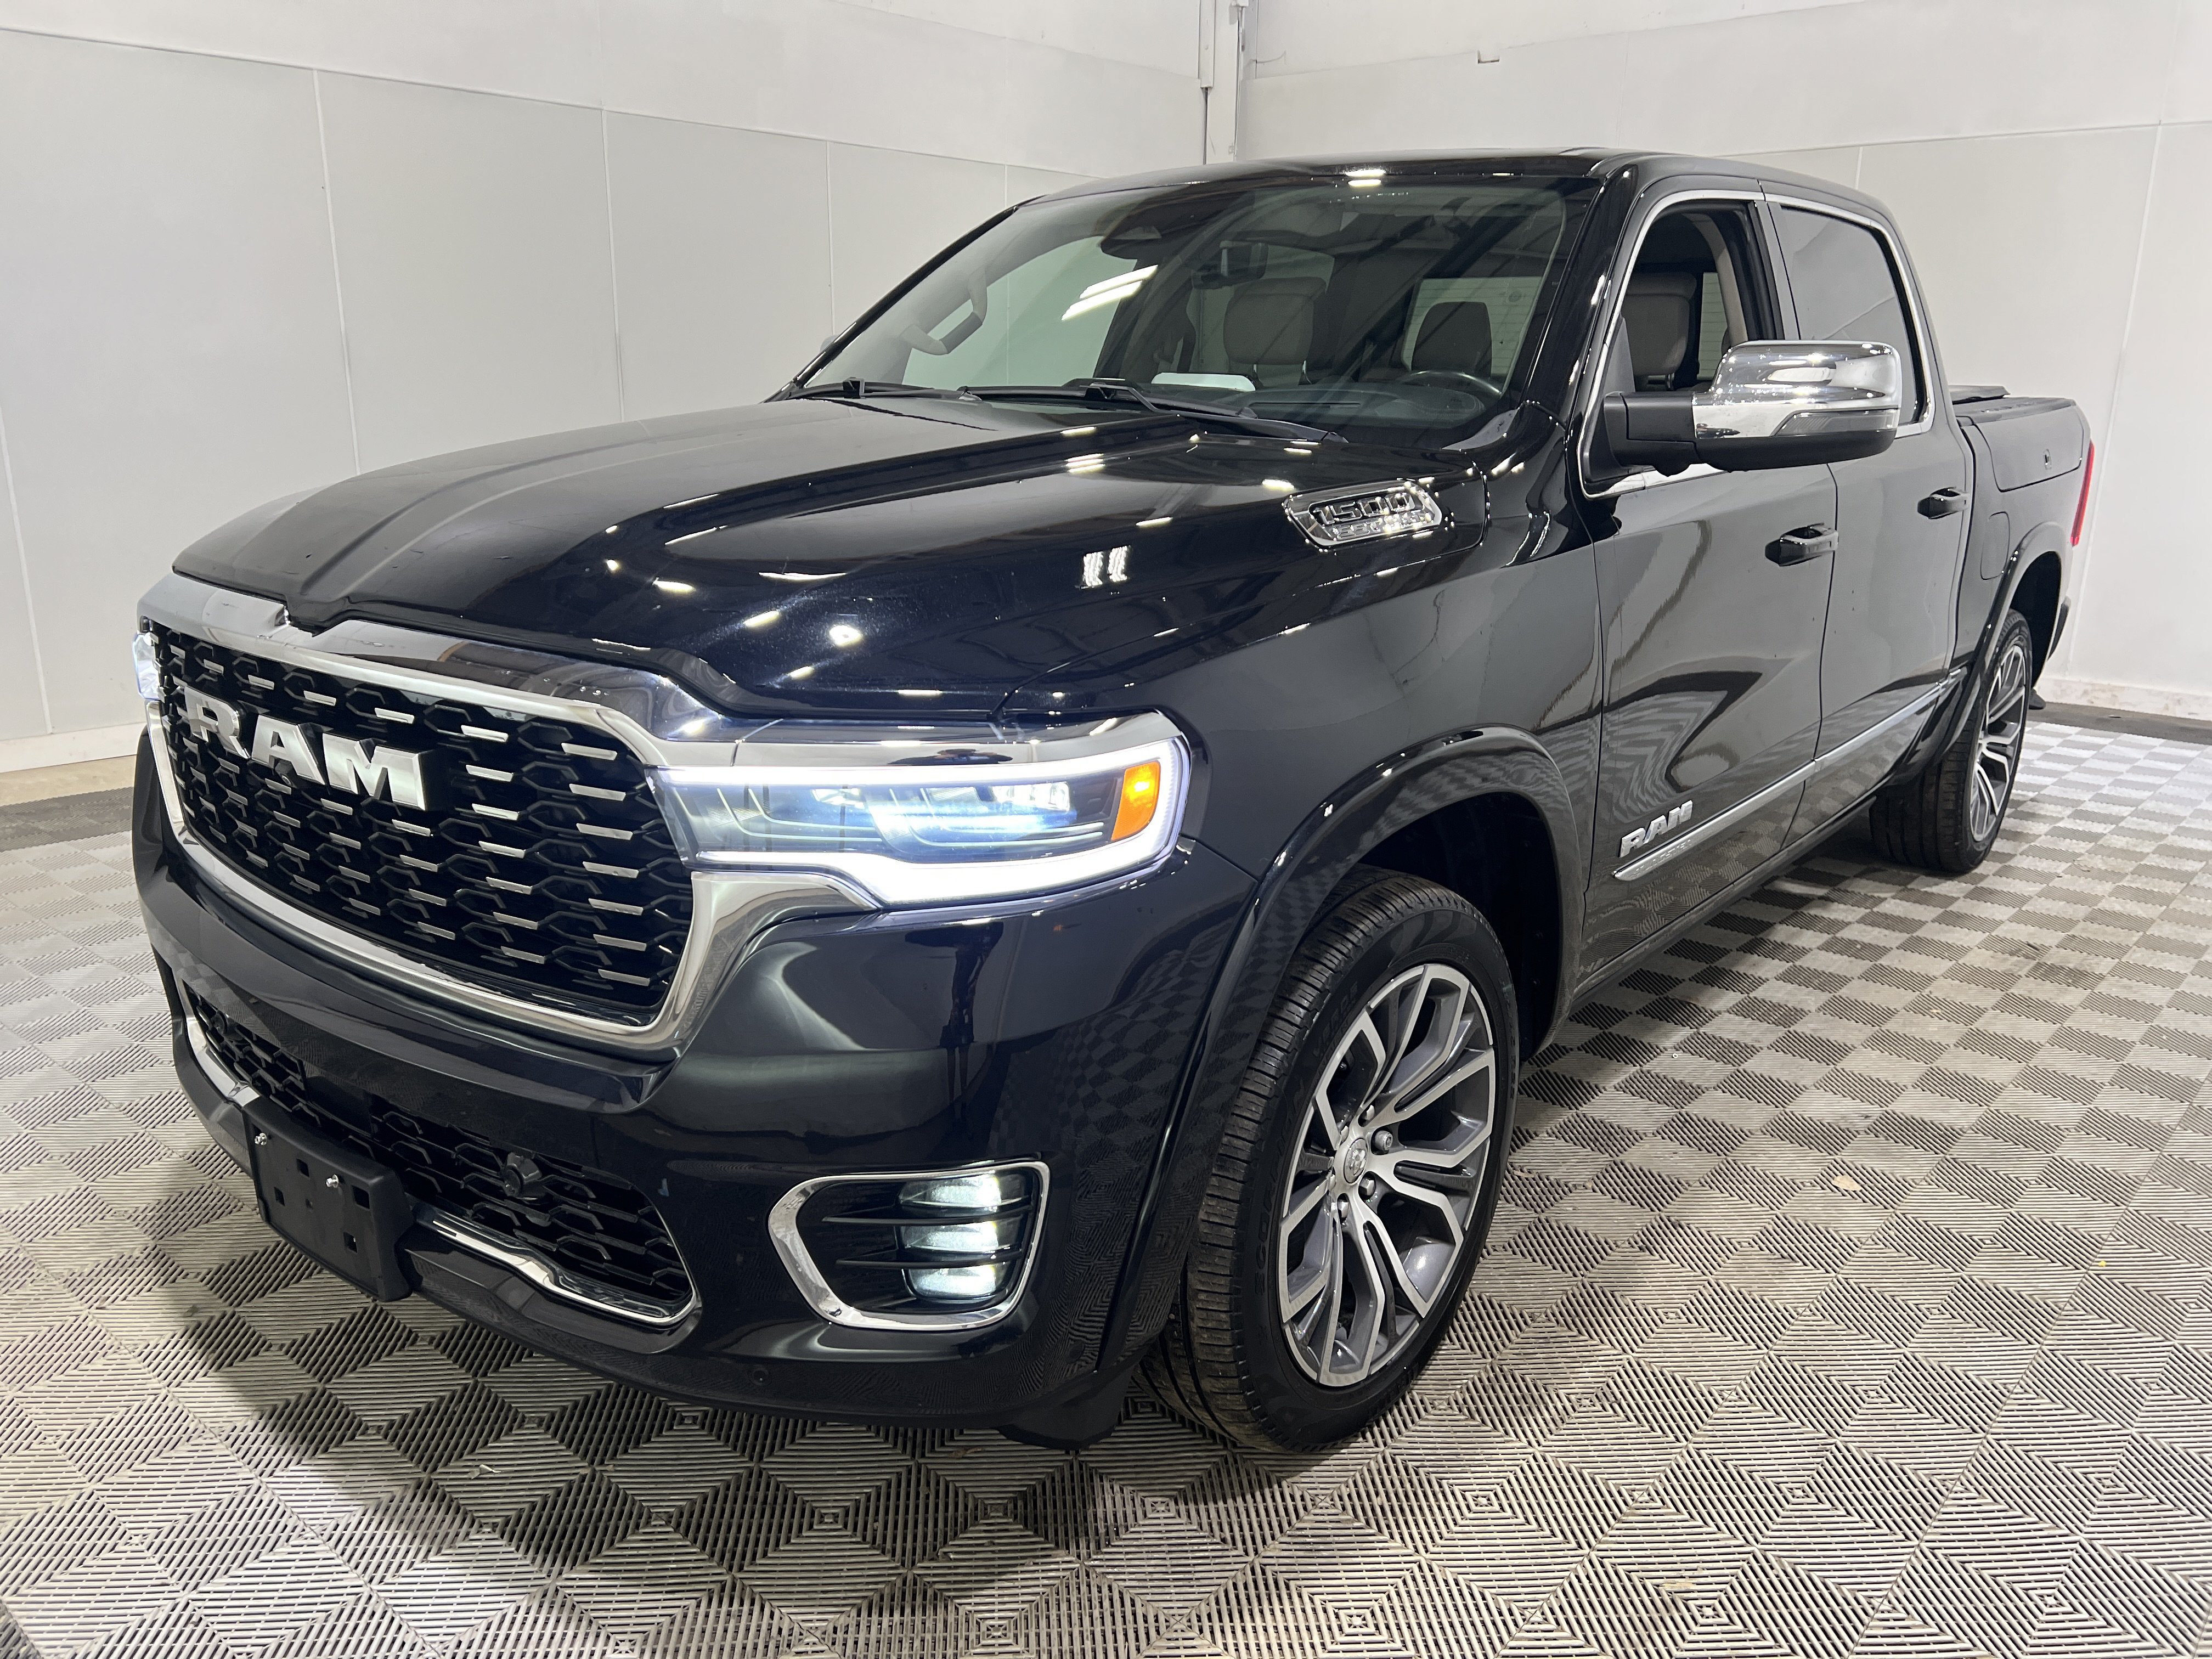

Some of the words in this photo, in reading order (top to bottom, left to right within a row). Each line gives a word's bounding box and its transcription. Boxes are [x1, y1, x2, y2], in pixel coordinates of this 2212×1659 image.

[1313, 492, 1416, 525] 1500
[185, 686, 427, 811] RAM
[1620, 800, 1693, 858] RAM
